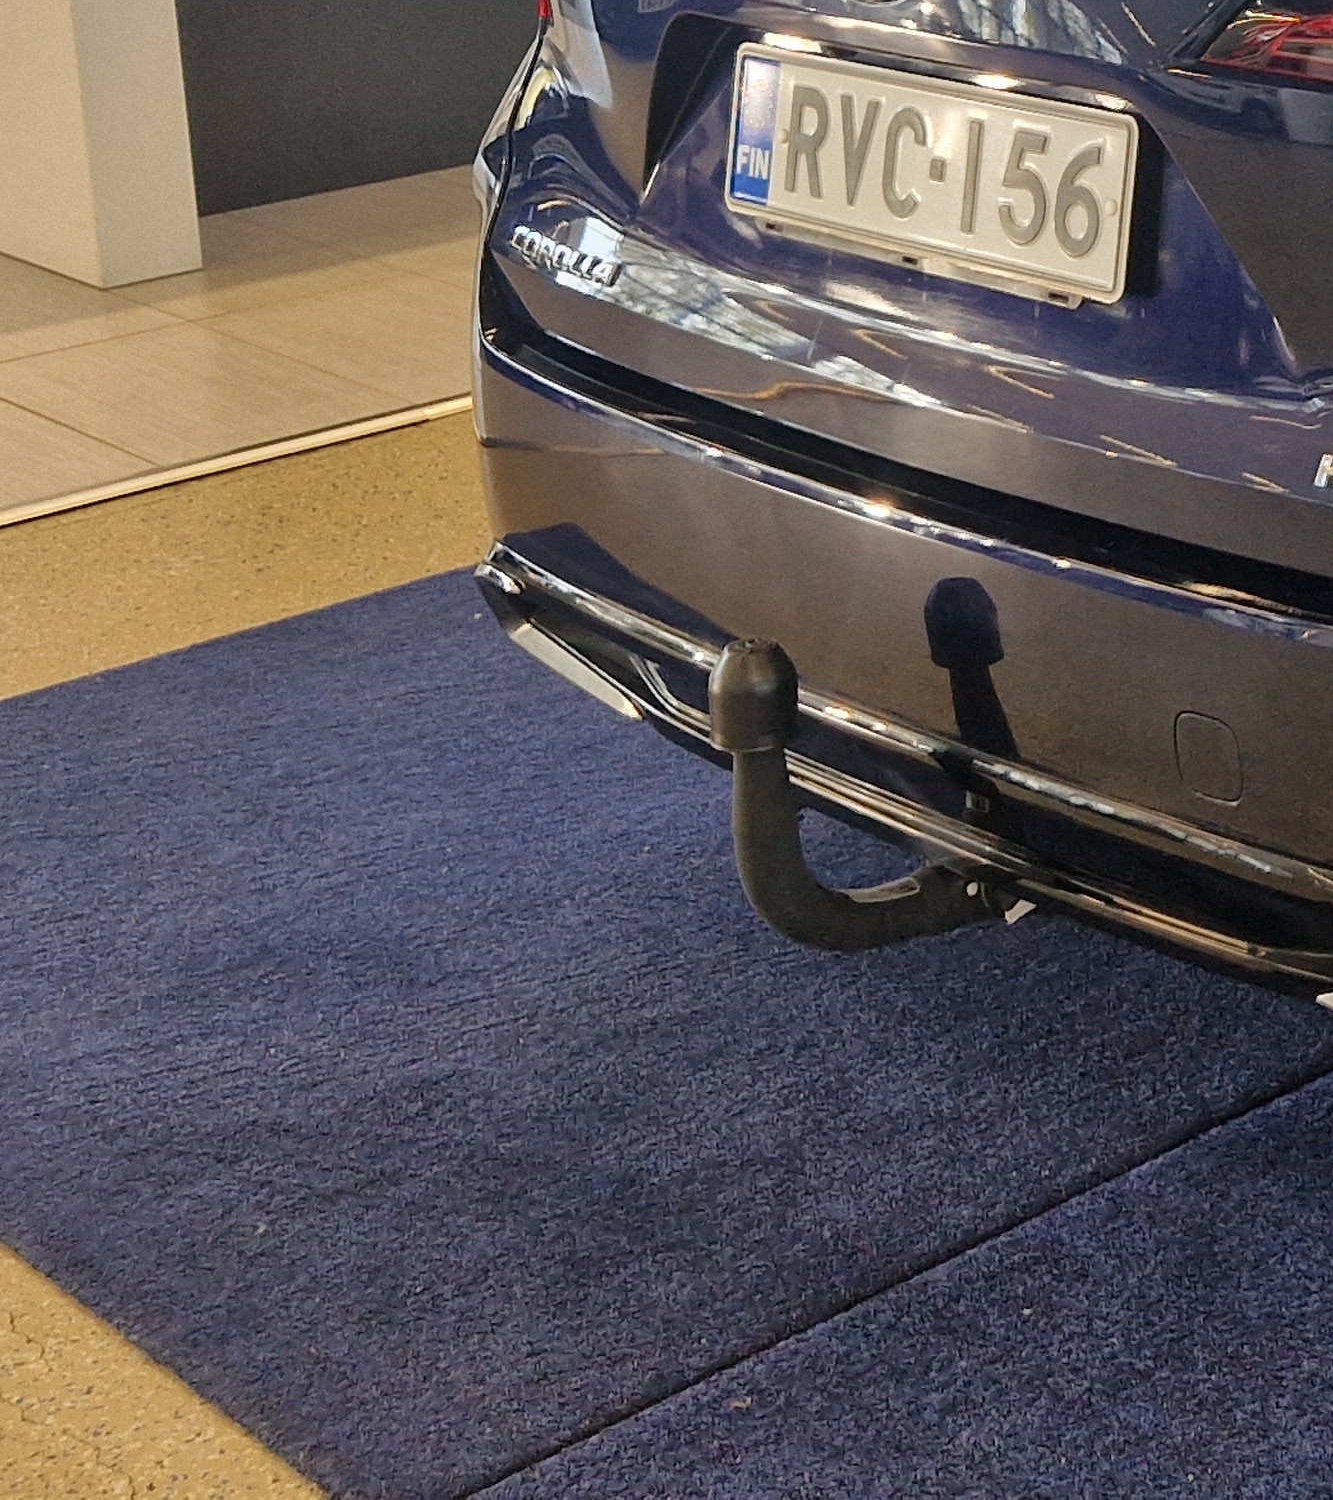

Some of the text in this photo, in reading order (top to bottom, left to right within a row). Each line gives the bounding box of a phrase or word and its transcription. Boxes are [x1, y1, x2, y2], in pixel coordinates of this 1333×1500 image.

[736, 143, 771, 182] FIN
[783, 85, 1105, 259] RVC-156
[509, 225, 622, 287] COROLLA
